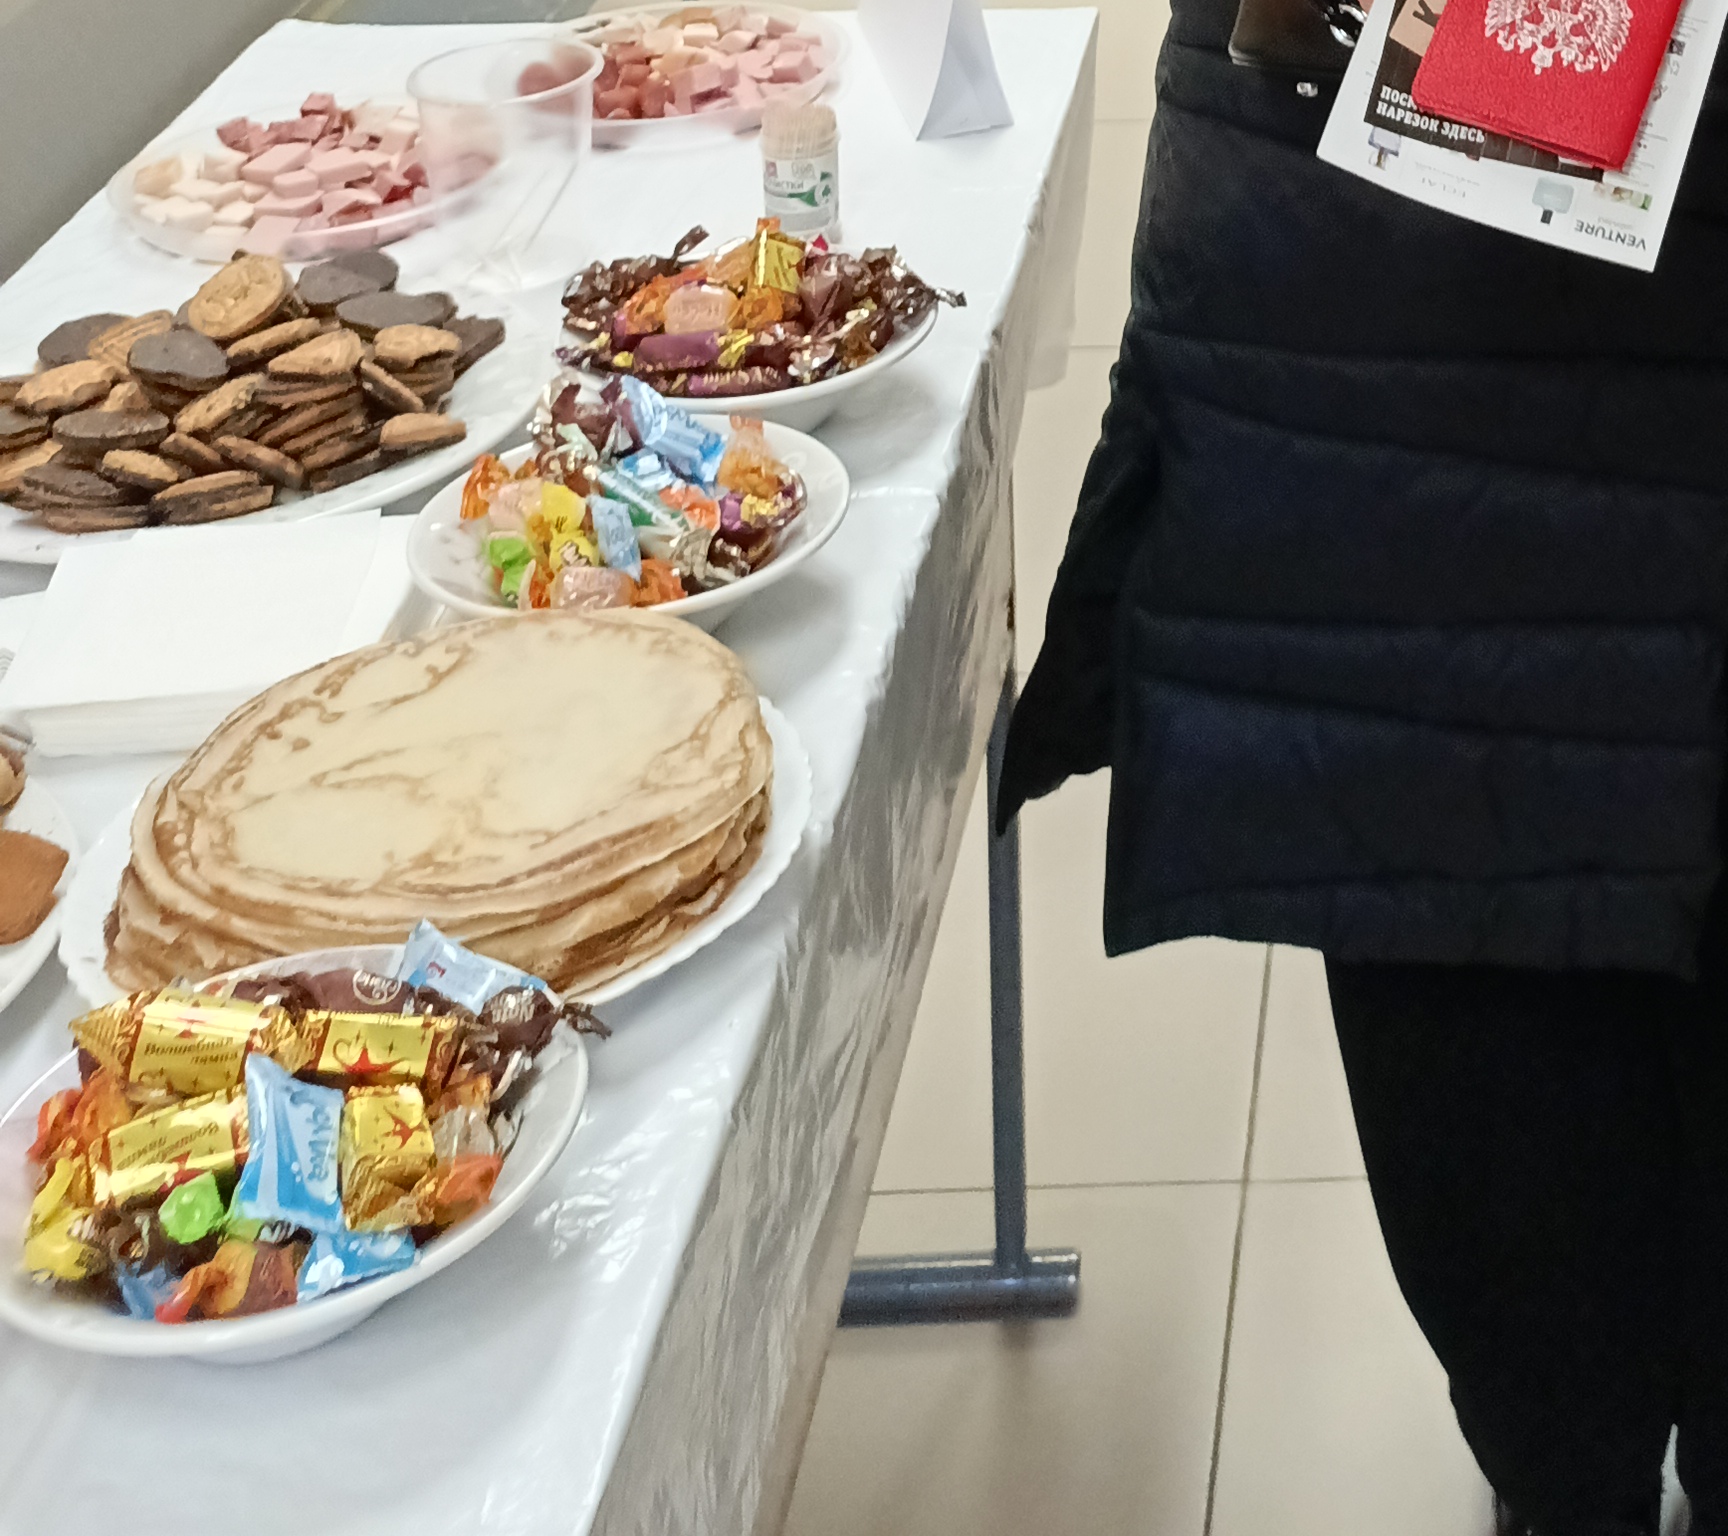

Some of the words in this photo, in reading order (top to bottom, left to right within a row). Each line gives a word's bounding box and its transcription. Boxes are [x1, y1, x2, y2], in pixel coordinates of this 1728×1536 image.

[1376, 100, 1439, 132] НАРЕЗОК
[1441, 121, 1486, 144] ЗДЕСЬ
[1574, 218, 1647, 251] VENTURE
